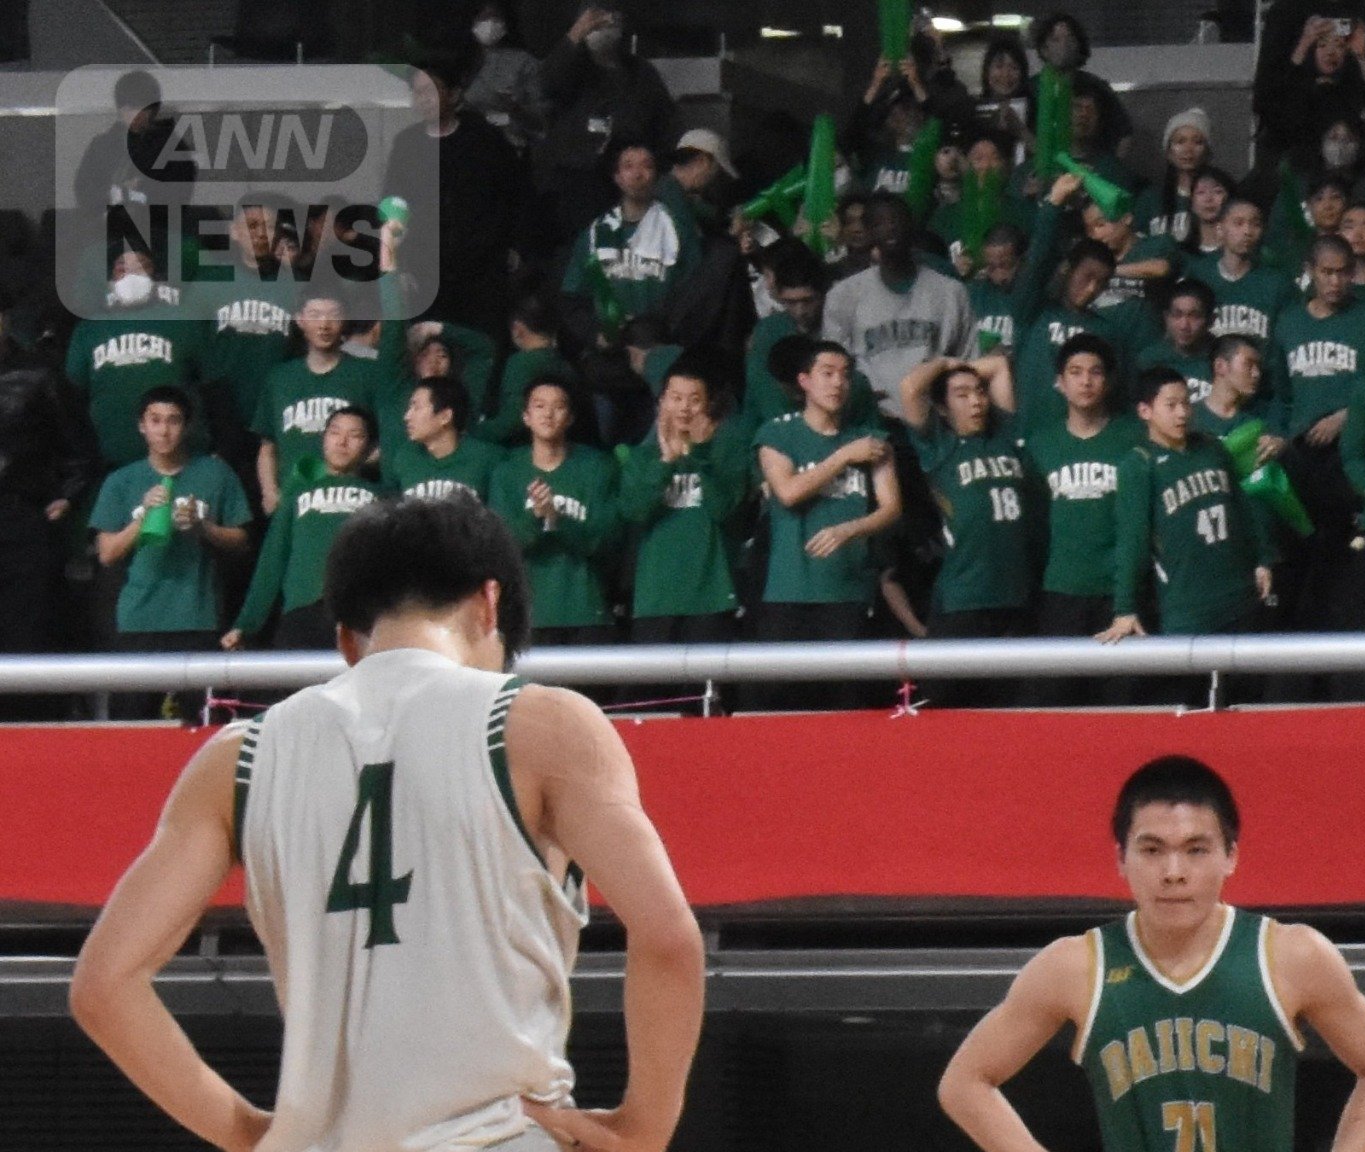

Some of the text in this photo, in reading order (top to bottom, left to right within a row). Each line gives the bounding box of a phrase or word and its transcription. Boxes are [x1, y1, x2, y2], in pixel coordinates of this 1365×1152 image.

[989, 487, 1021, 522] 18
[1197, 504, 1228, 544] 47
[325, 759, 414, 950] 4
[1100, 1018, 1275, 1101] DAIICHI
